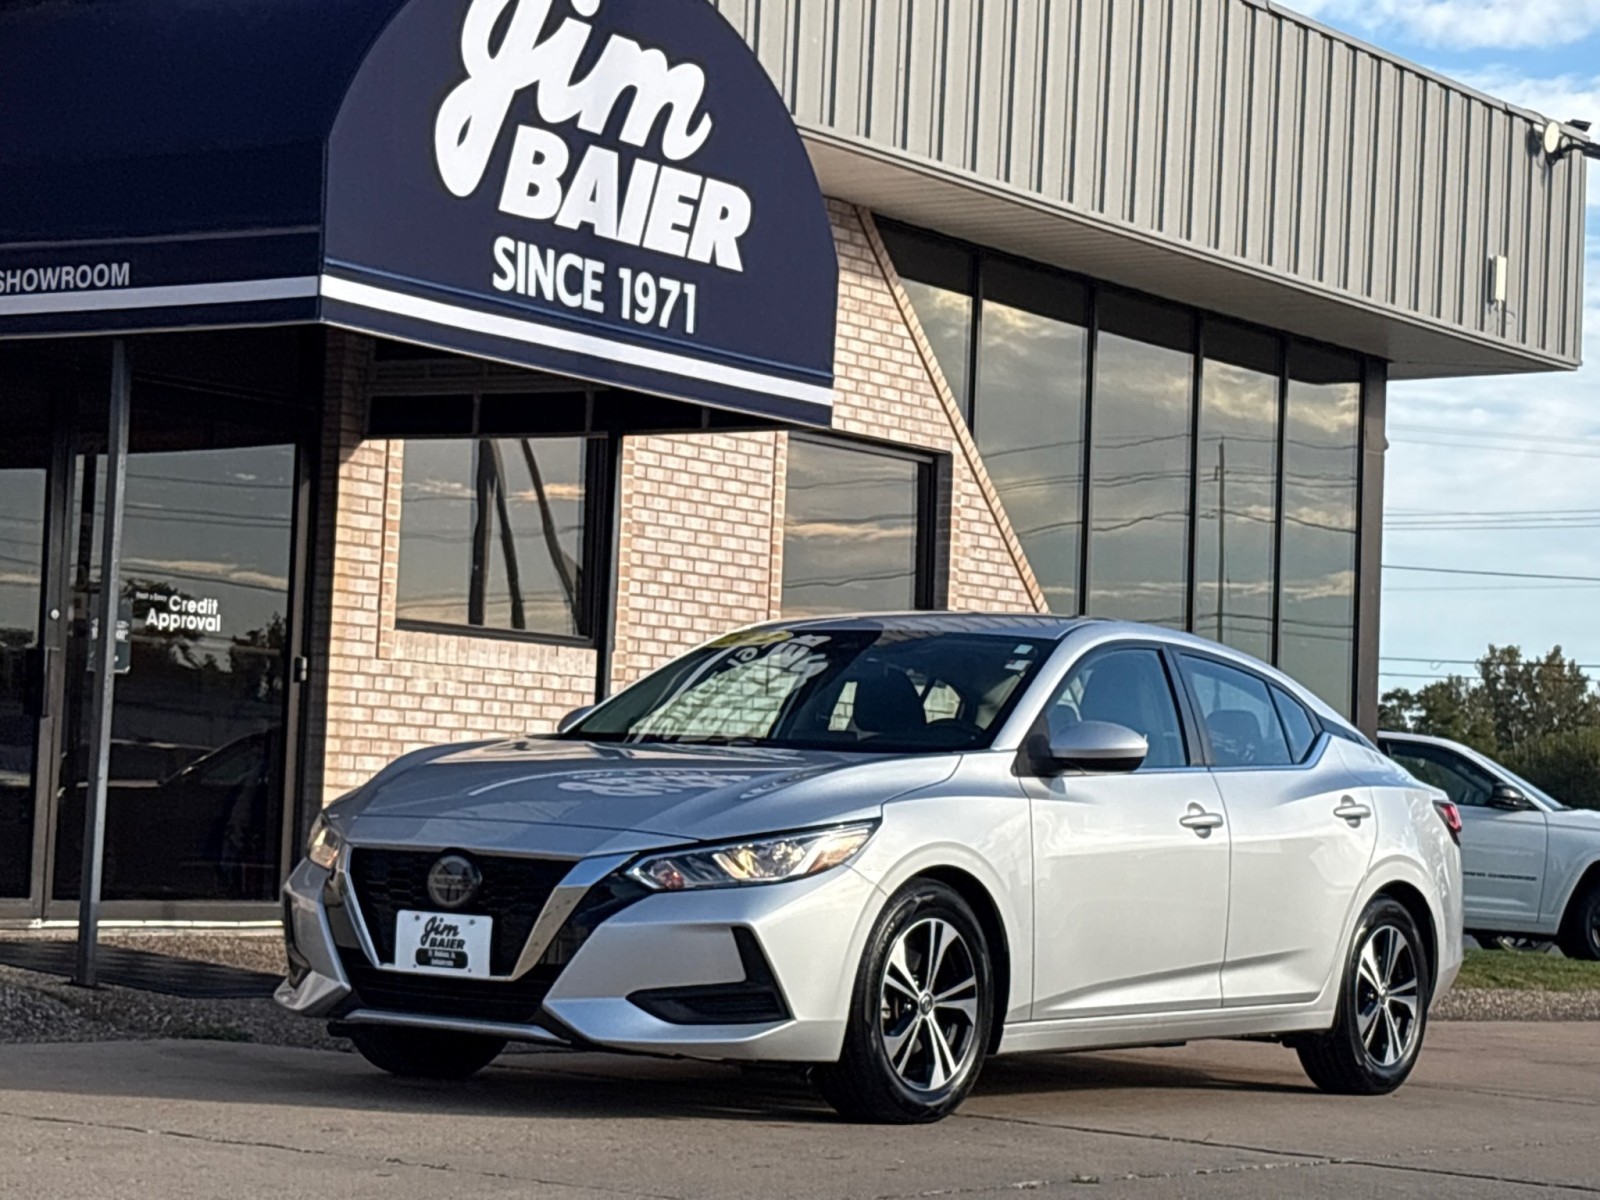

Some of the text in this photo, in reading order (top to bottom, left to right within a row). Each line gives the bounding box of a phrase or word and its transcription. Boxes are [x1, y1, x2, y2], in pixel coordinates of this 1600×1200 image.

[435, 0, 712, 197] Jim
[499, 125, 752, 272] BAIER
[493, 236, 697, 333] SINCE 1971
[145, 607, 221, 632] Approval
[169, 595, 218, 615] Credit
[420, 916, 459, 946] Jim
